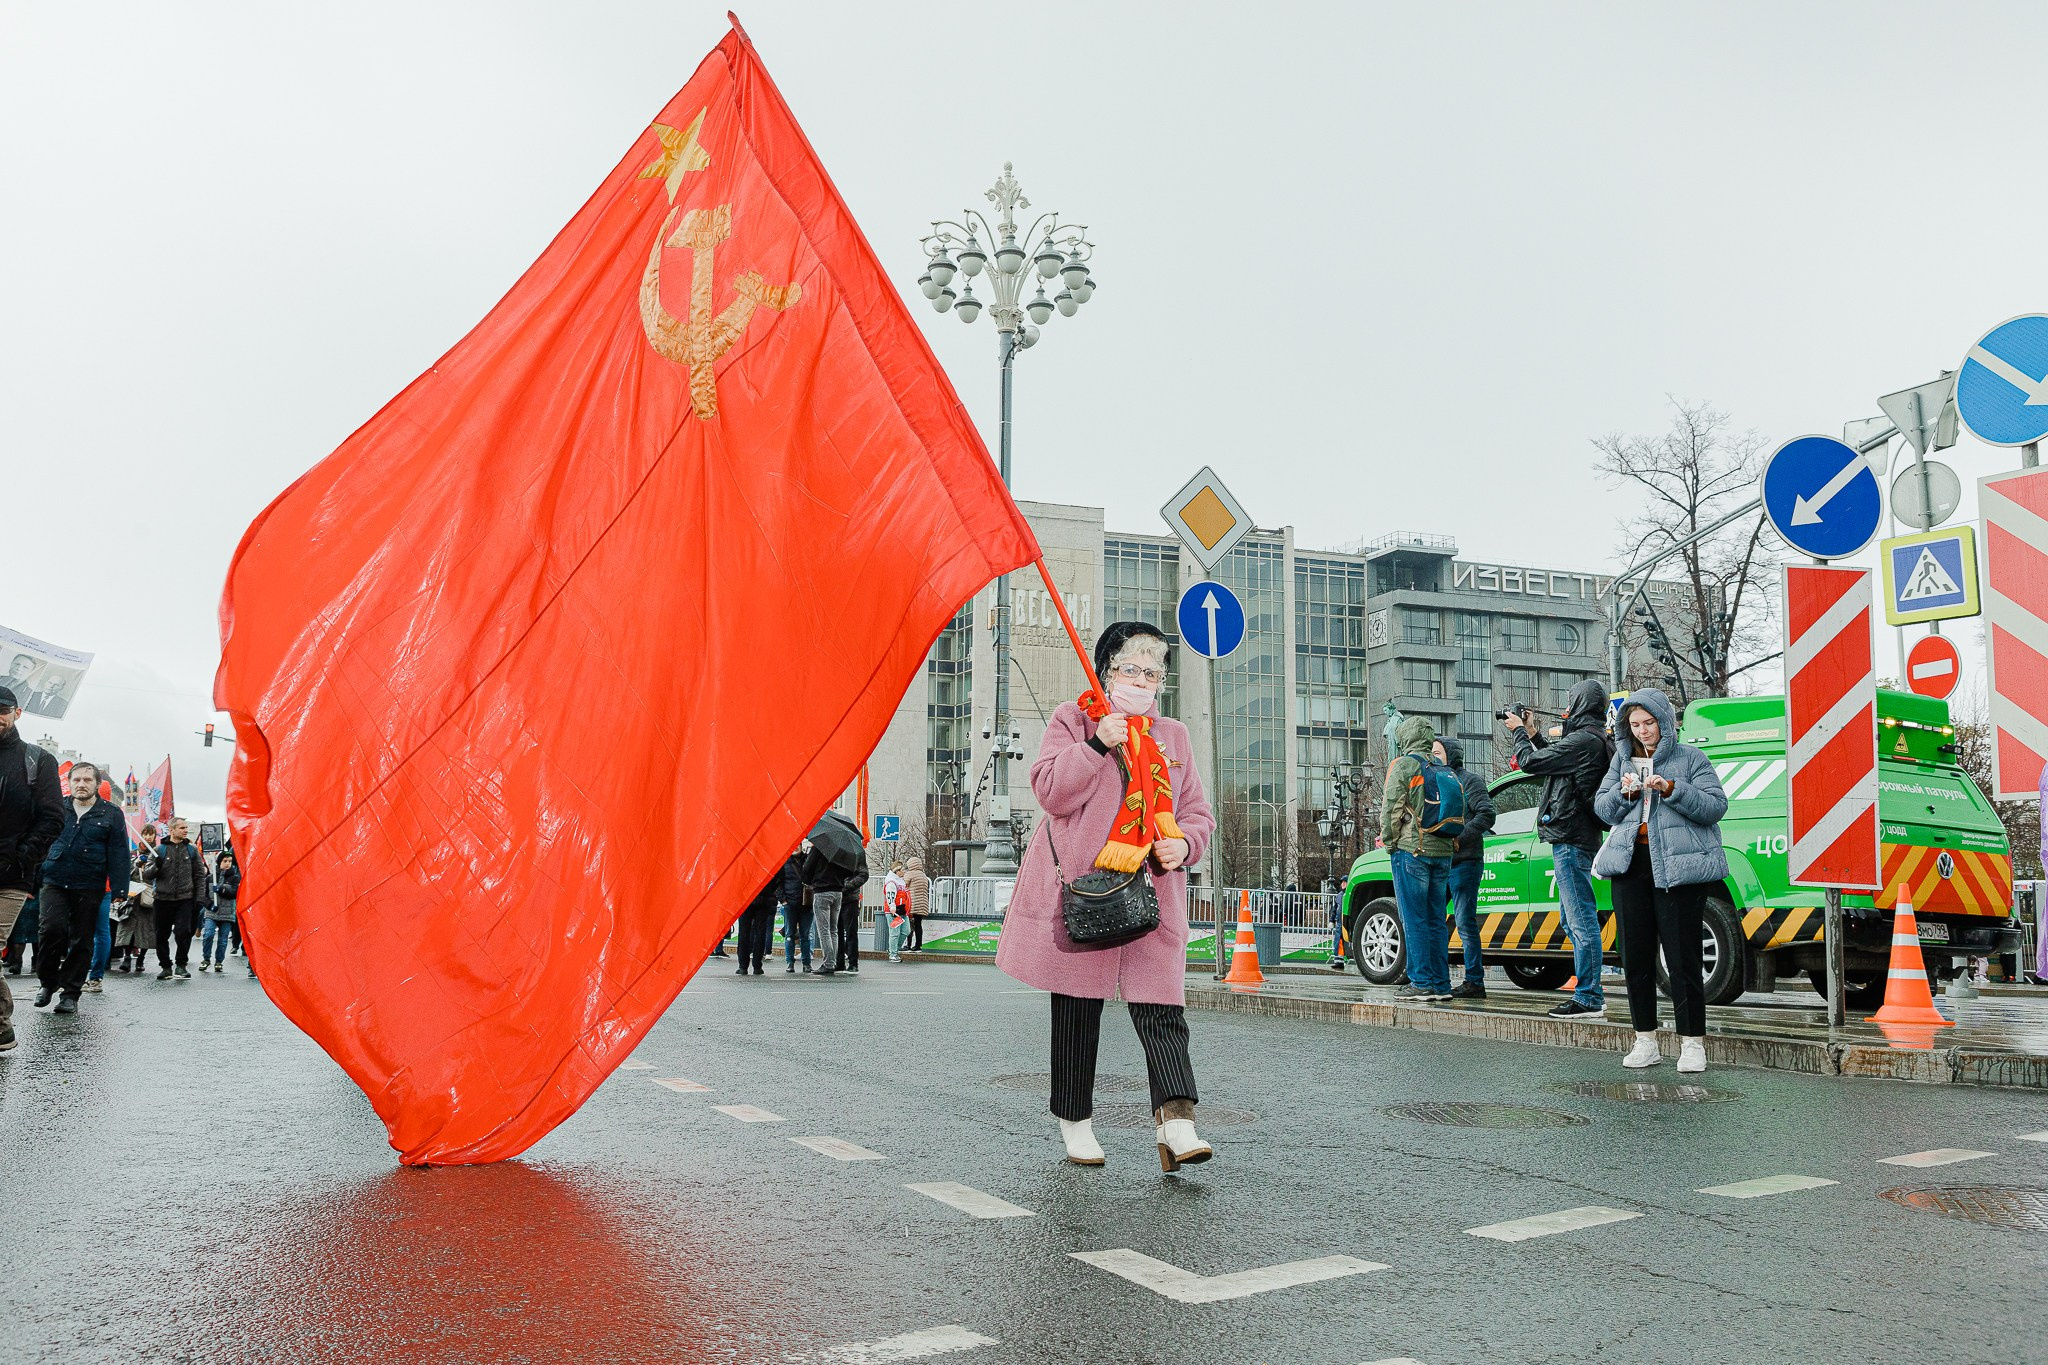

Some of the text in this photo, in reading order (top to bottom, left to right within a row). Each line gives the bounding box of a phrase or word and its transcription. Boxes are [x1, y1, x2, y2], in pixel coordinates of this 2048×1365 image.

[1453, 562, 1638, 604] ИЗВЕСТИЯ
[1925, 787, 1967, 800] патруль
[1887, 826, 1907, 837] ЦОДД
[1932, 924, 1946, 935] 799
